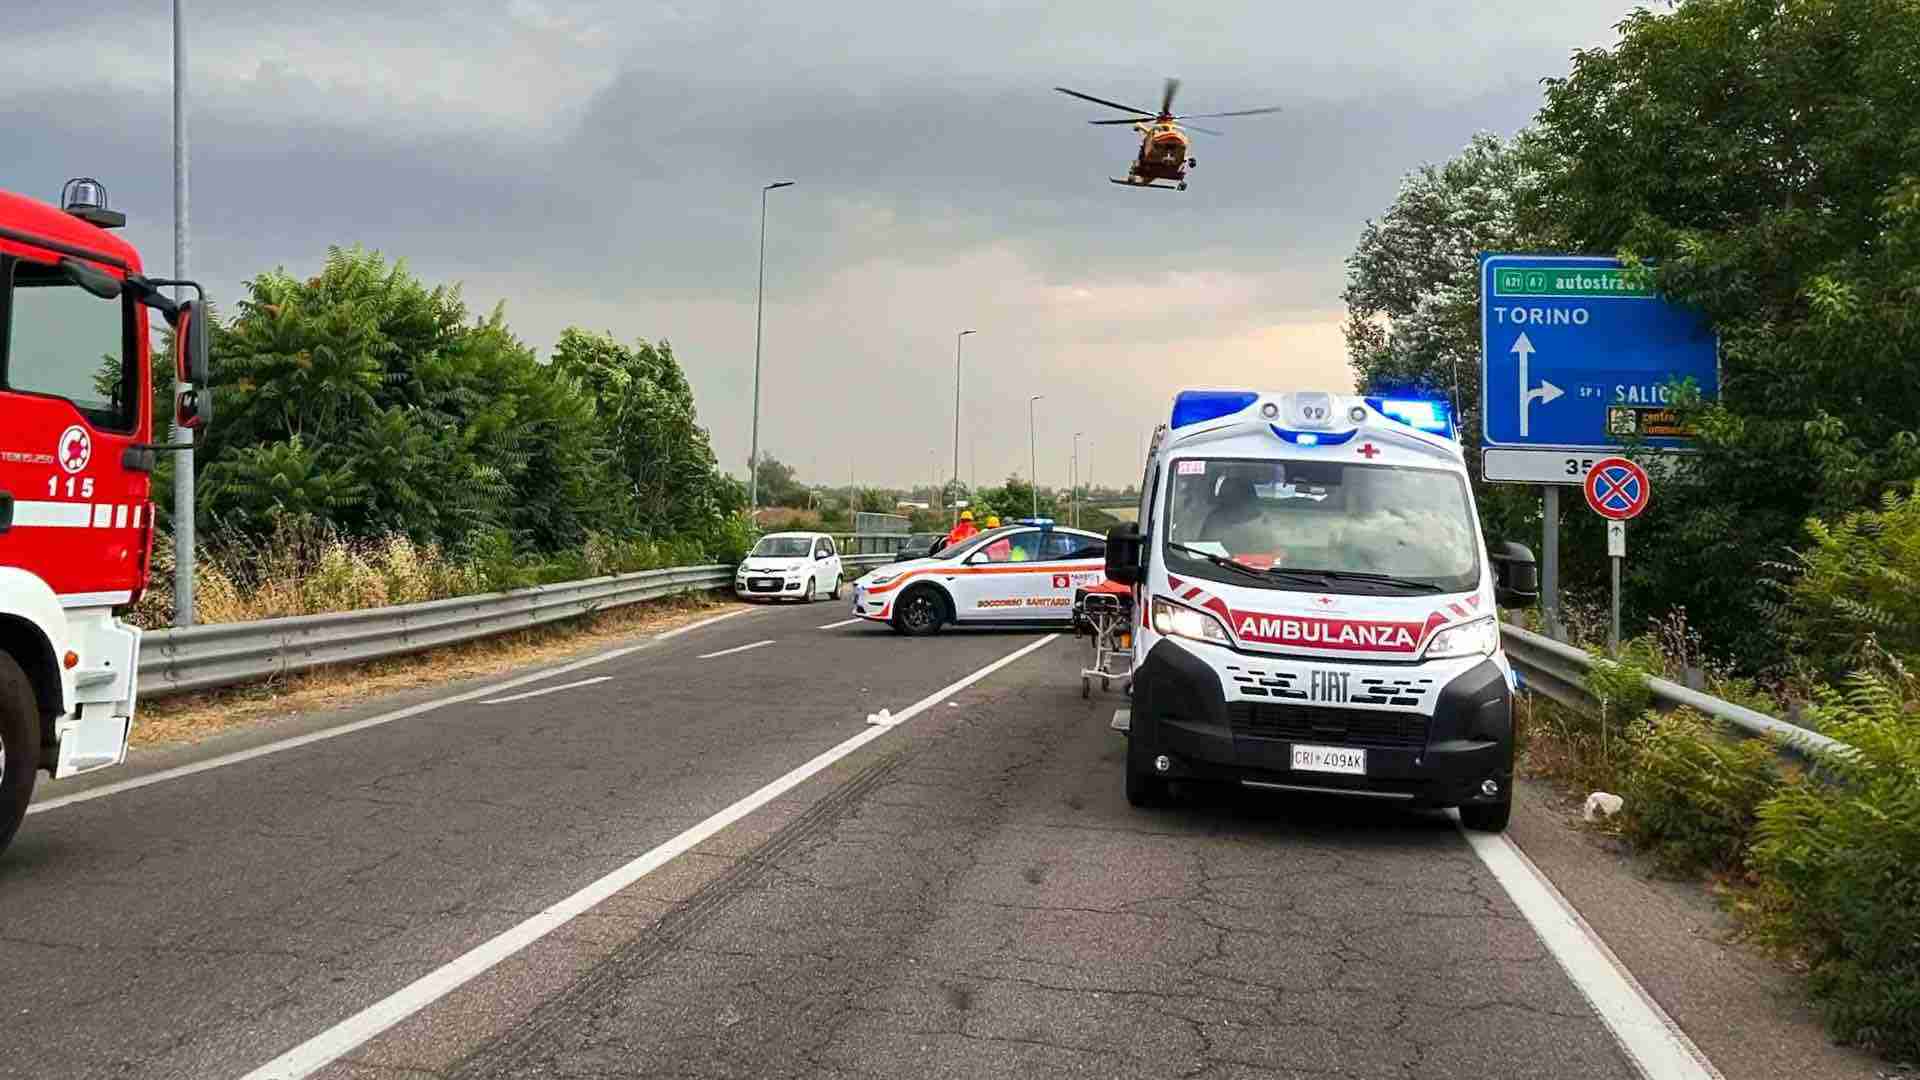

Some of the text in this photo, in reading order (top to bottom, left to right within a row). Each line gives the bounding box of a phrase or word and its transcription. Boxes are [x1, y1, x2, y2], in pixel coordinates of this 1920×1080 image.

[1493, 307, 1590, 325] TORINO
[1615, 384, 1678, 403] SALIC
[47, 475, 95, 497] 115
[1238, 616, 1417, 648] AMBULANZA
[1311, 670, 1351, 702] FIAT
